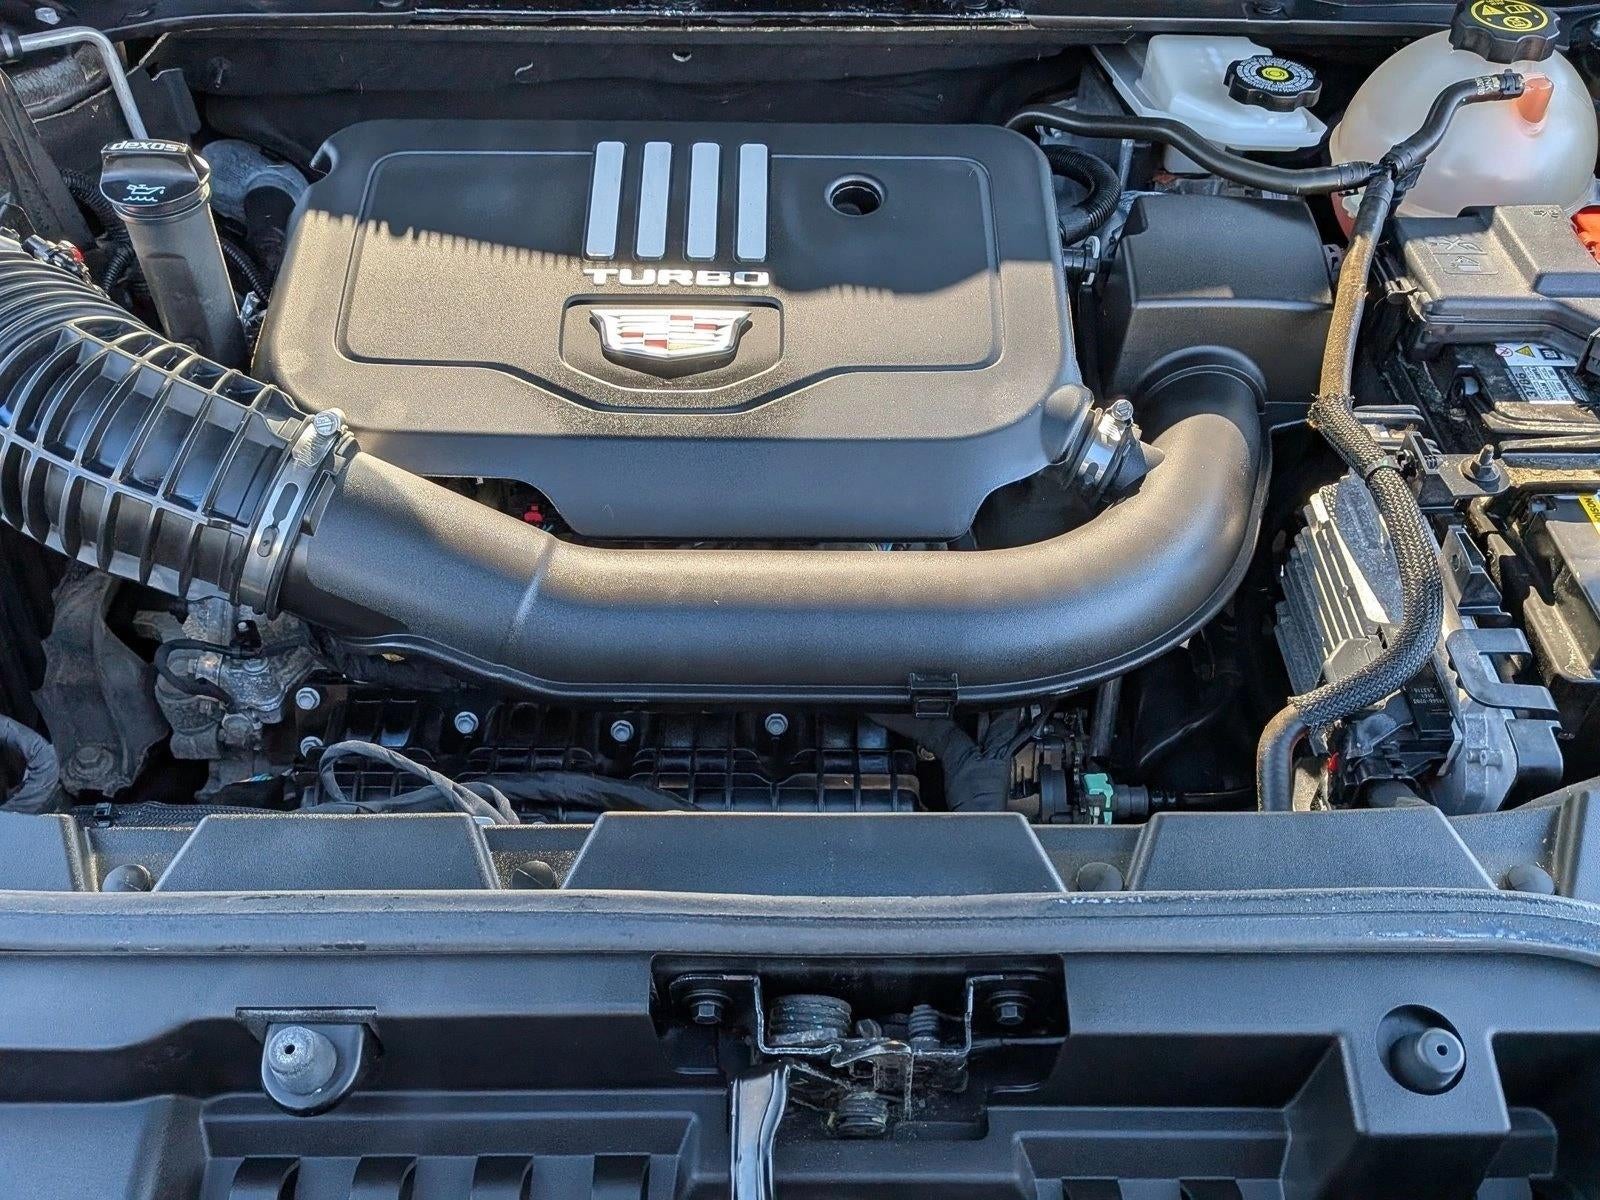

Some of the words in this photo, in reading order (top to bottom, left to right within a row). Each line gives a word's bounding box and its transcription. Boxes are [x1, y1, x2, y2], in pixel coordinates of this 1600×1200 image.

[109, 141, 178, 152] dexos
[582, 268, 770, 287] TURBO
[1583, 496, 1600, 521] OISON
